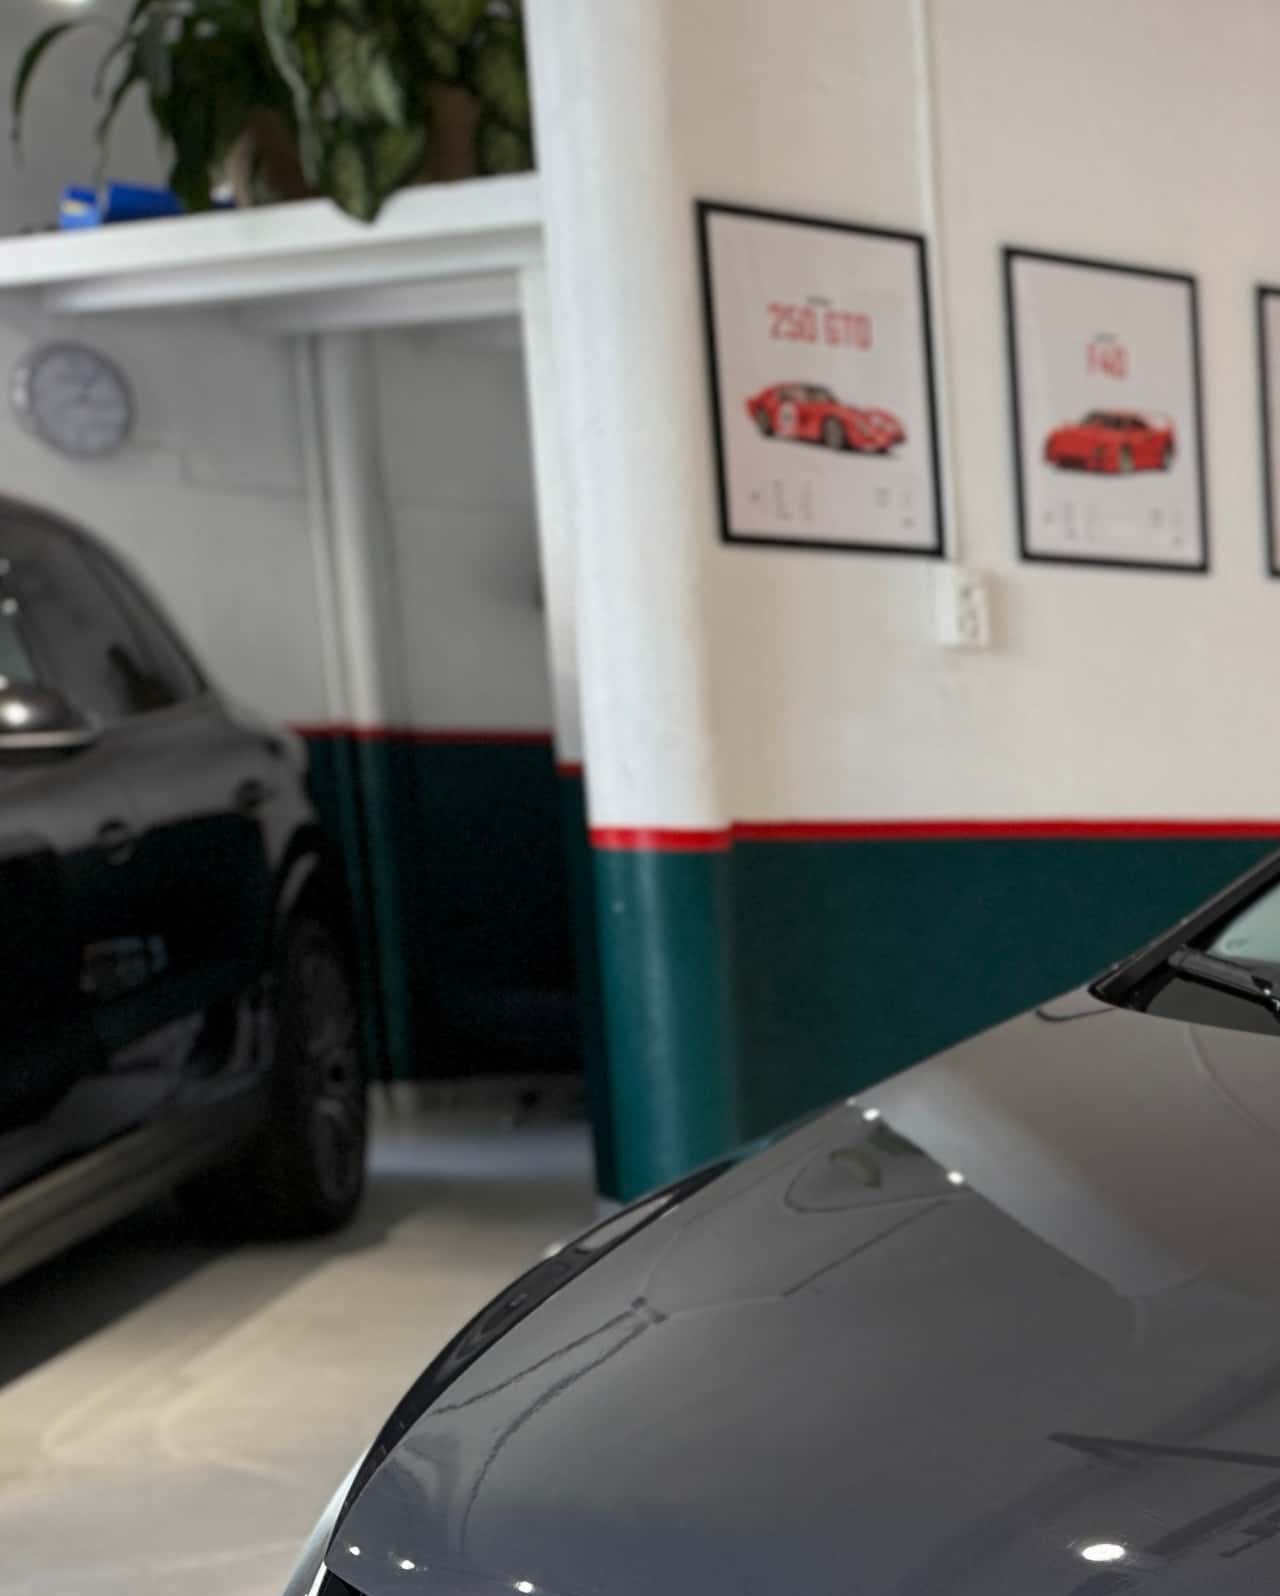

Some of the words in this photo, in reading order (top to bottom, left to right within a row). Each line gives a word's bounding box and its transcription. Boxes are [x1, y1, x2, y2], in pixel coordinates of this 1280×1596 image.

[767, 302, 819, 342] 250
[822, 310, 872, 351] GTO
[1087, 343, 1130, 381] F40
